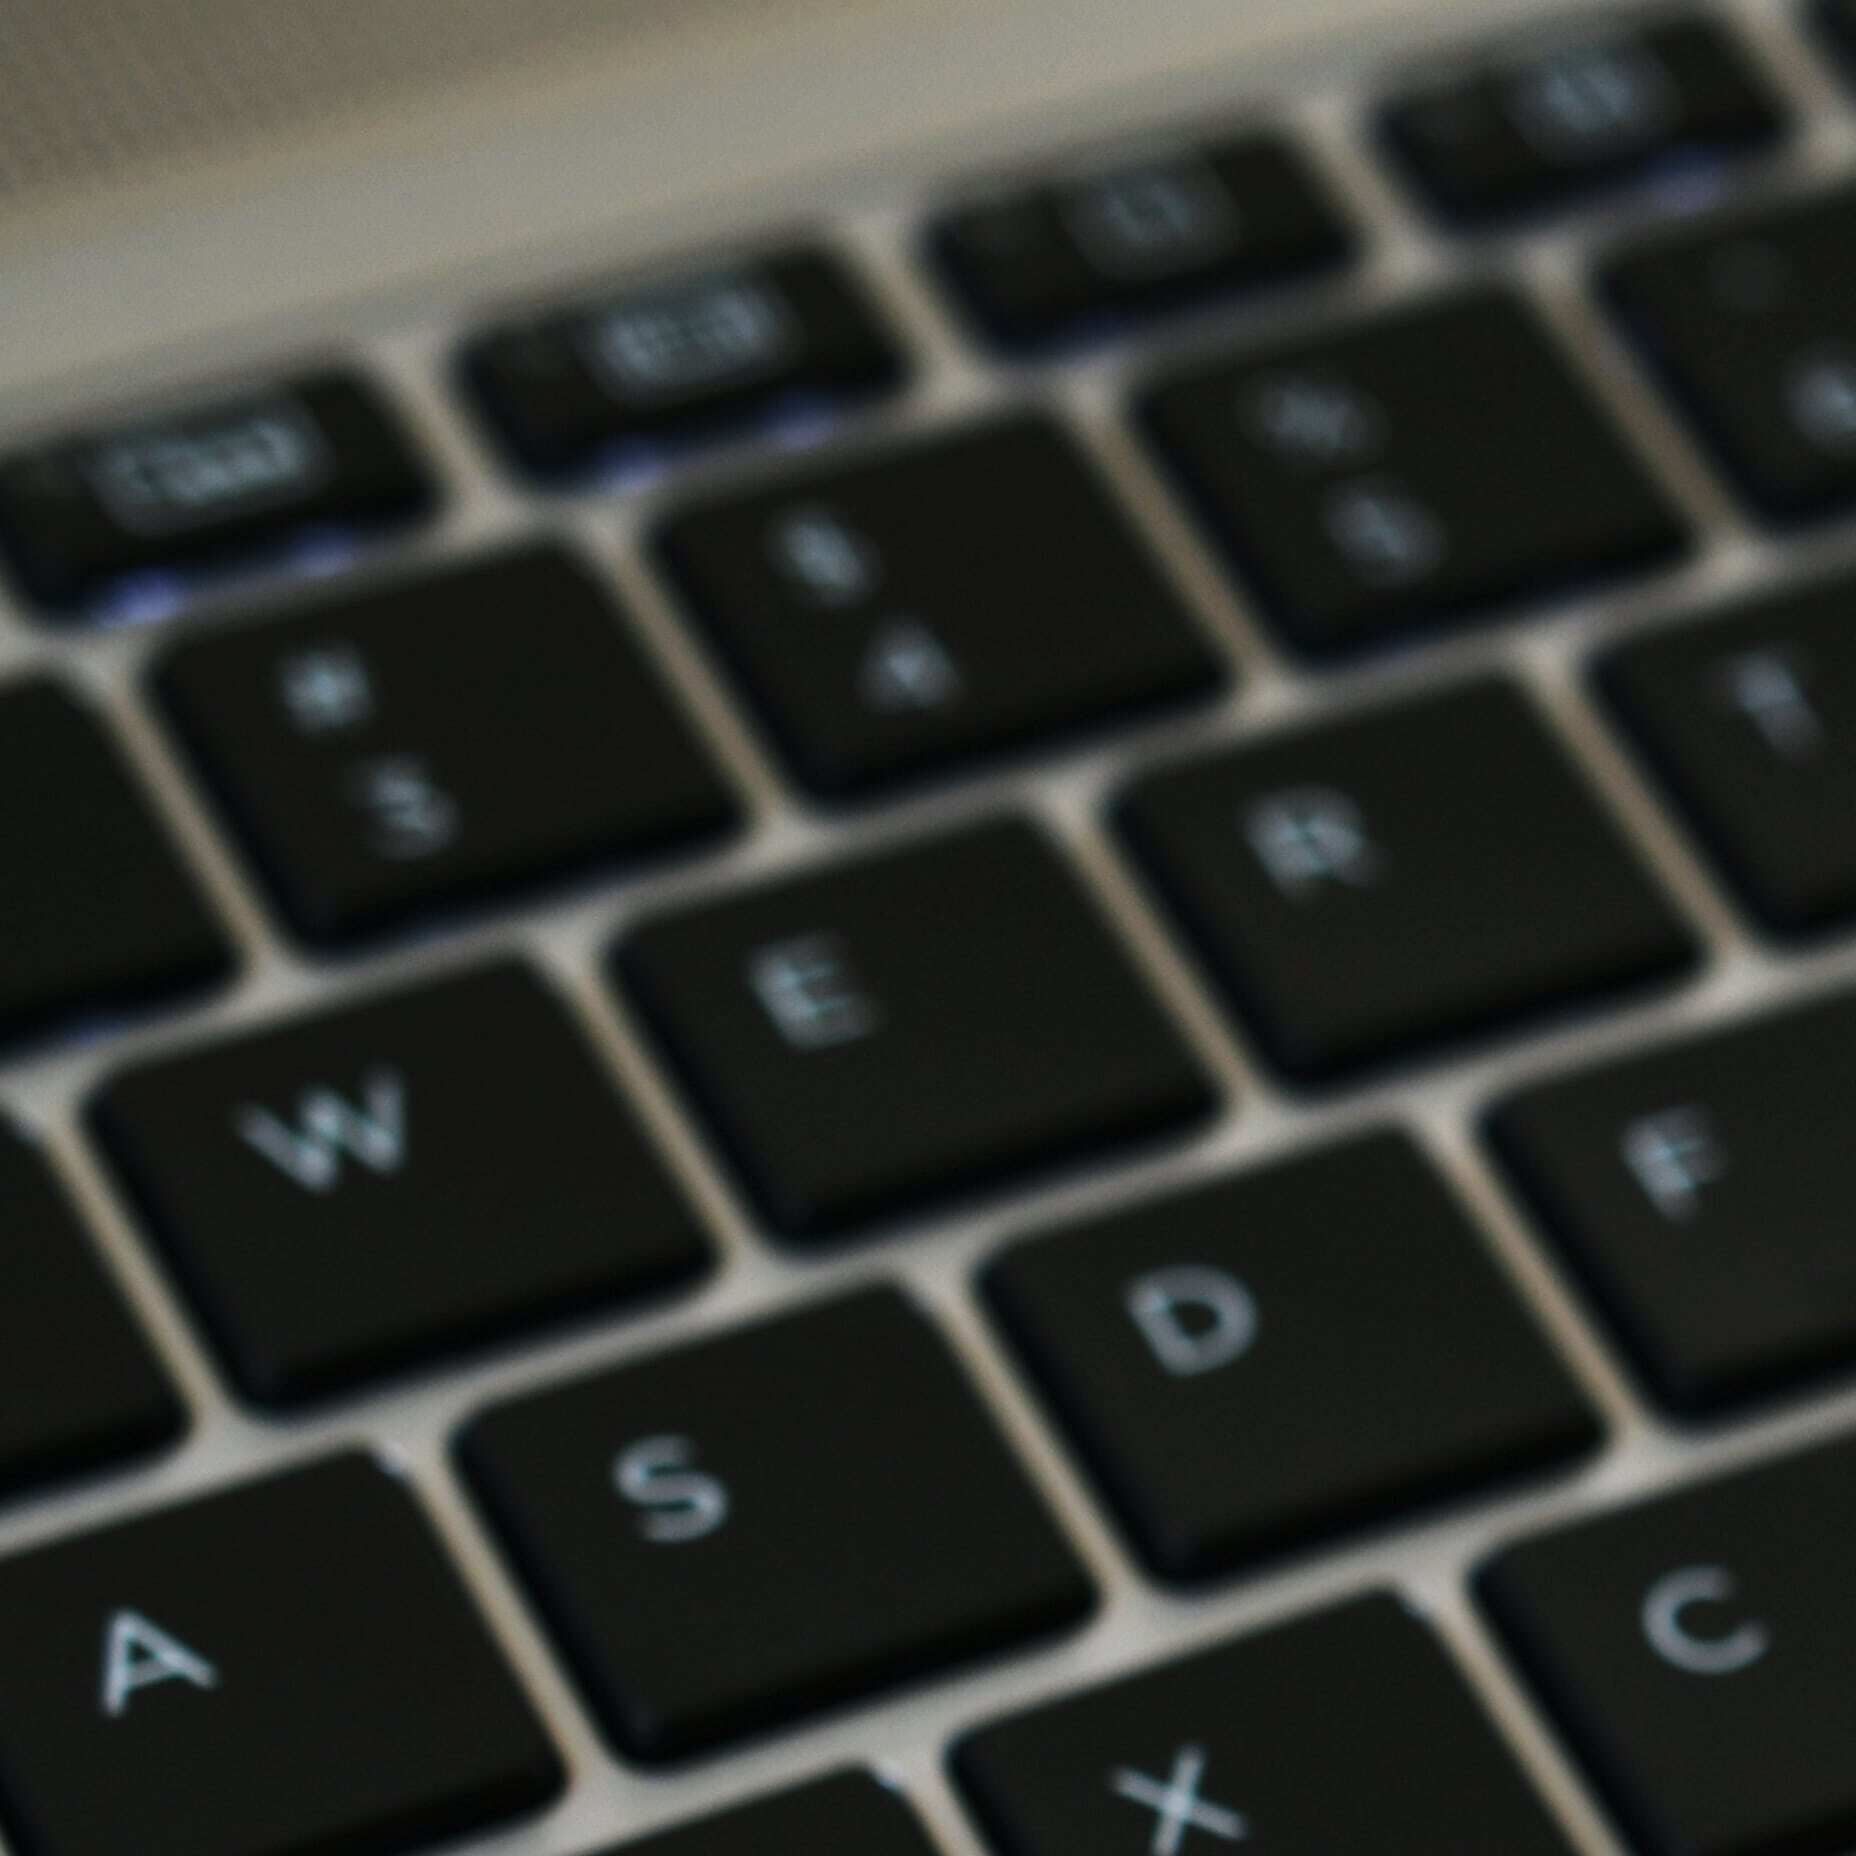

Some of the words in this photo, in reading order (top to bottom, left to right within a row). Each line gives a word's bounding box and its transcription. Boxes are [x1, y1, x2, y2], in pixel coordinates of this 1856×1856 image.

[1246, 792, 1370, 894] R
[750, 938, 868, 1048] E
[238, 1070, 408, 1192] W
[1620, 1104, 1724, 1218] F
[1125, 1266, 1259, 1377] D
[612, 1436, 729, 1543] S
[102, 1611, 216, 1717] A
[1640, 1566, 1768, 1675] C
